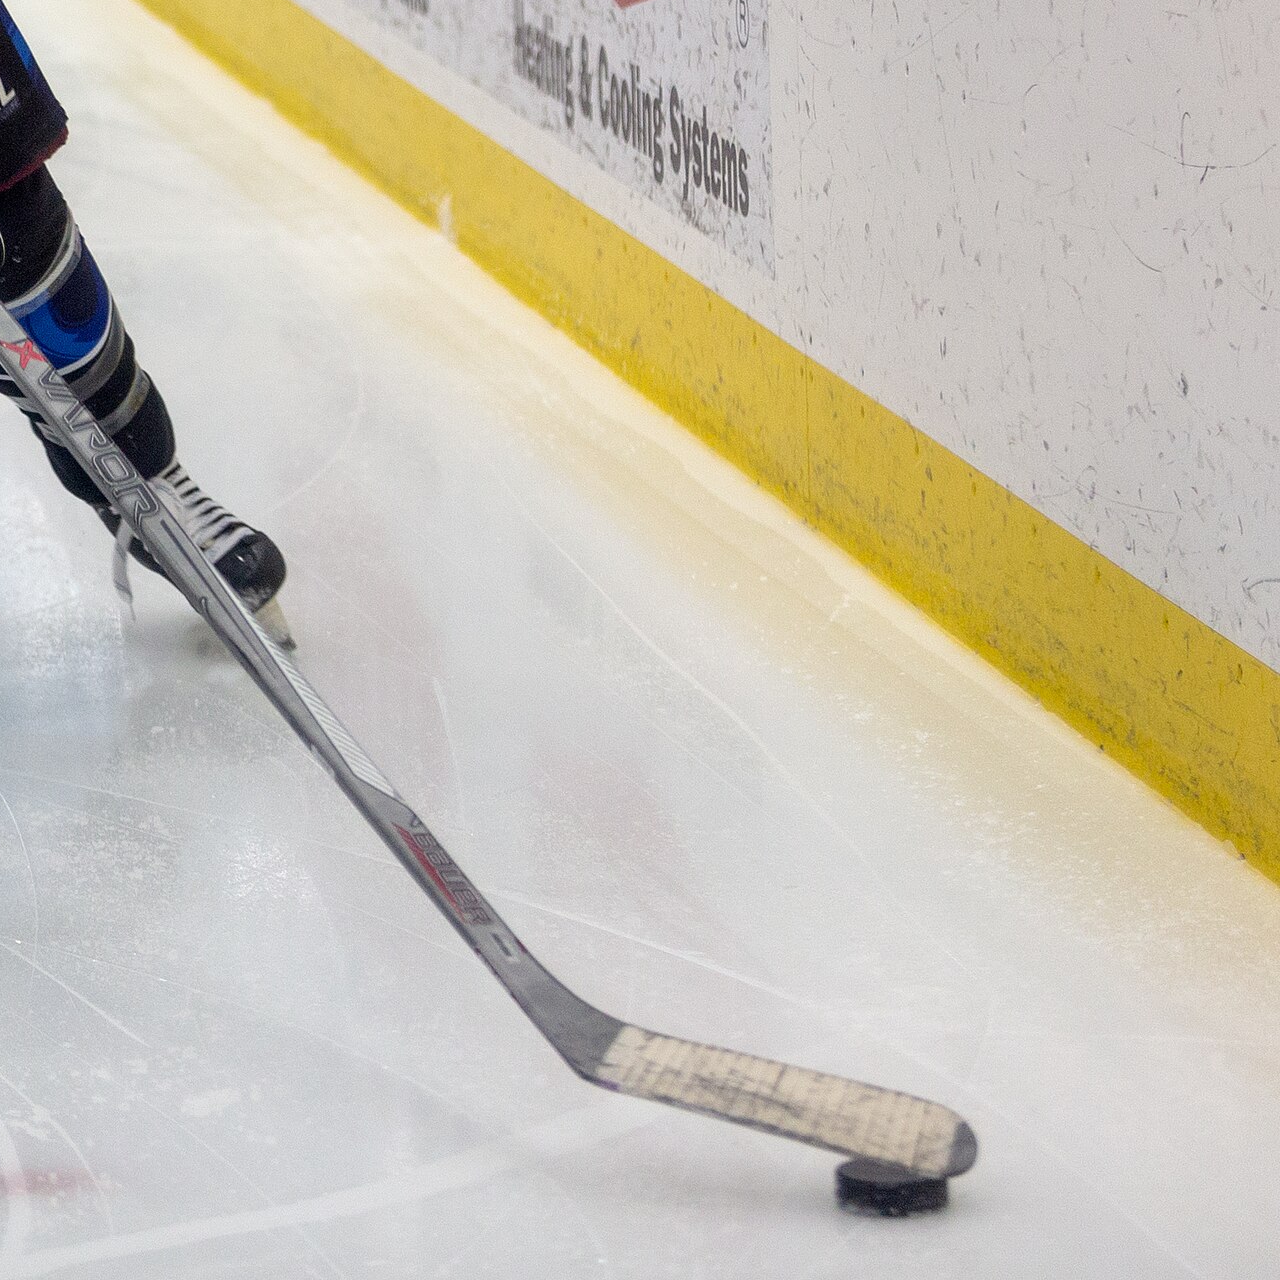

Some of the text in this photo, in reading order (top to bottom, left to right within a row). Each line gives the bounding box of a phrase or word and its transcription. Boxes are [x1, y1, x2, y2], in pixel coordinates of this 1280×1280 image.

[578, 34, 593, 122] &
[598, 44, 666, 185] Cooling
[669, 85, 750, 217] Systems
